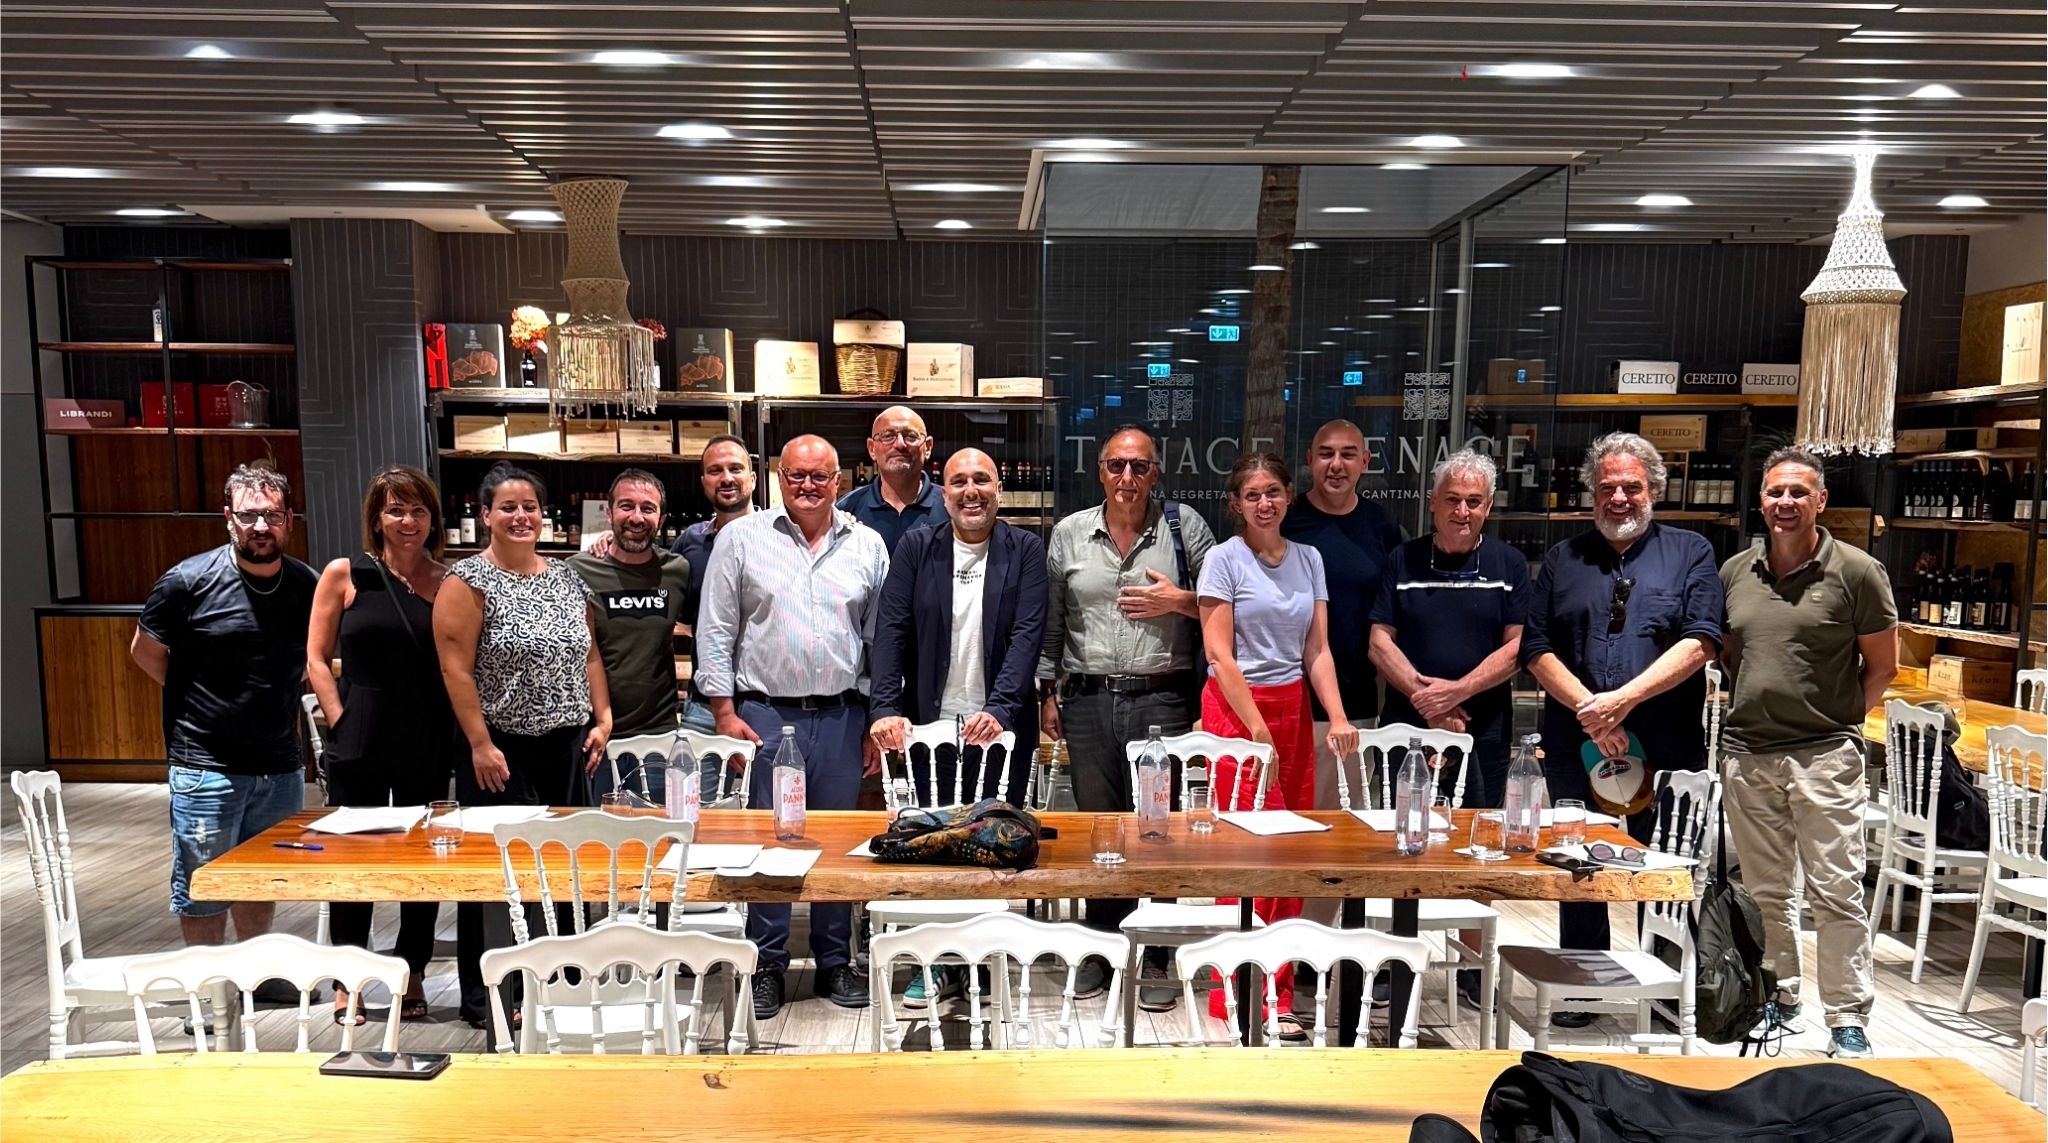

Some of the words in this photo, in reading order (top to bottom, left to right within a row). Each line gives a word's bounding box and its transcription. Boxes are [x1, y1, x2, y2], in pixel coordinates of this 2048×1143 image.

[1622, 373, 1676, 385] CERETTO
[1684, 372, 1738, 384] CERETTO
[1745, 374, 1797, 386] CERETTO
[60, 410, 113, 418] LIBRANDI
[1650, 428, 1692, 437] CERETTO
[1065, 436, 1274, 475] TAC
[1363, 435, 1530, 474] ENAE
[1172, 490, 1228, 499] SEGRETA
[1362, 489, 1420, 499] CANTINA
[685, 794, 699, 806] PAN
[783, 794, 804, 804] PANN
[1154, 792, 1169, 803] PAN
